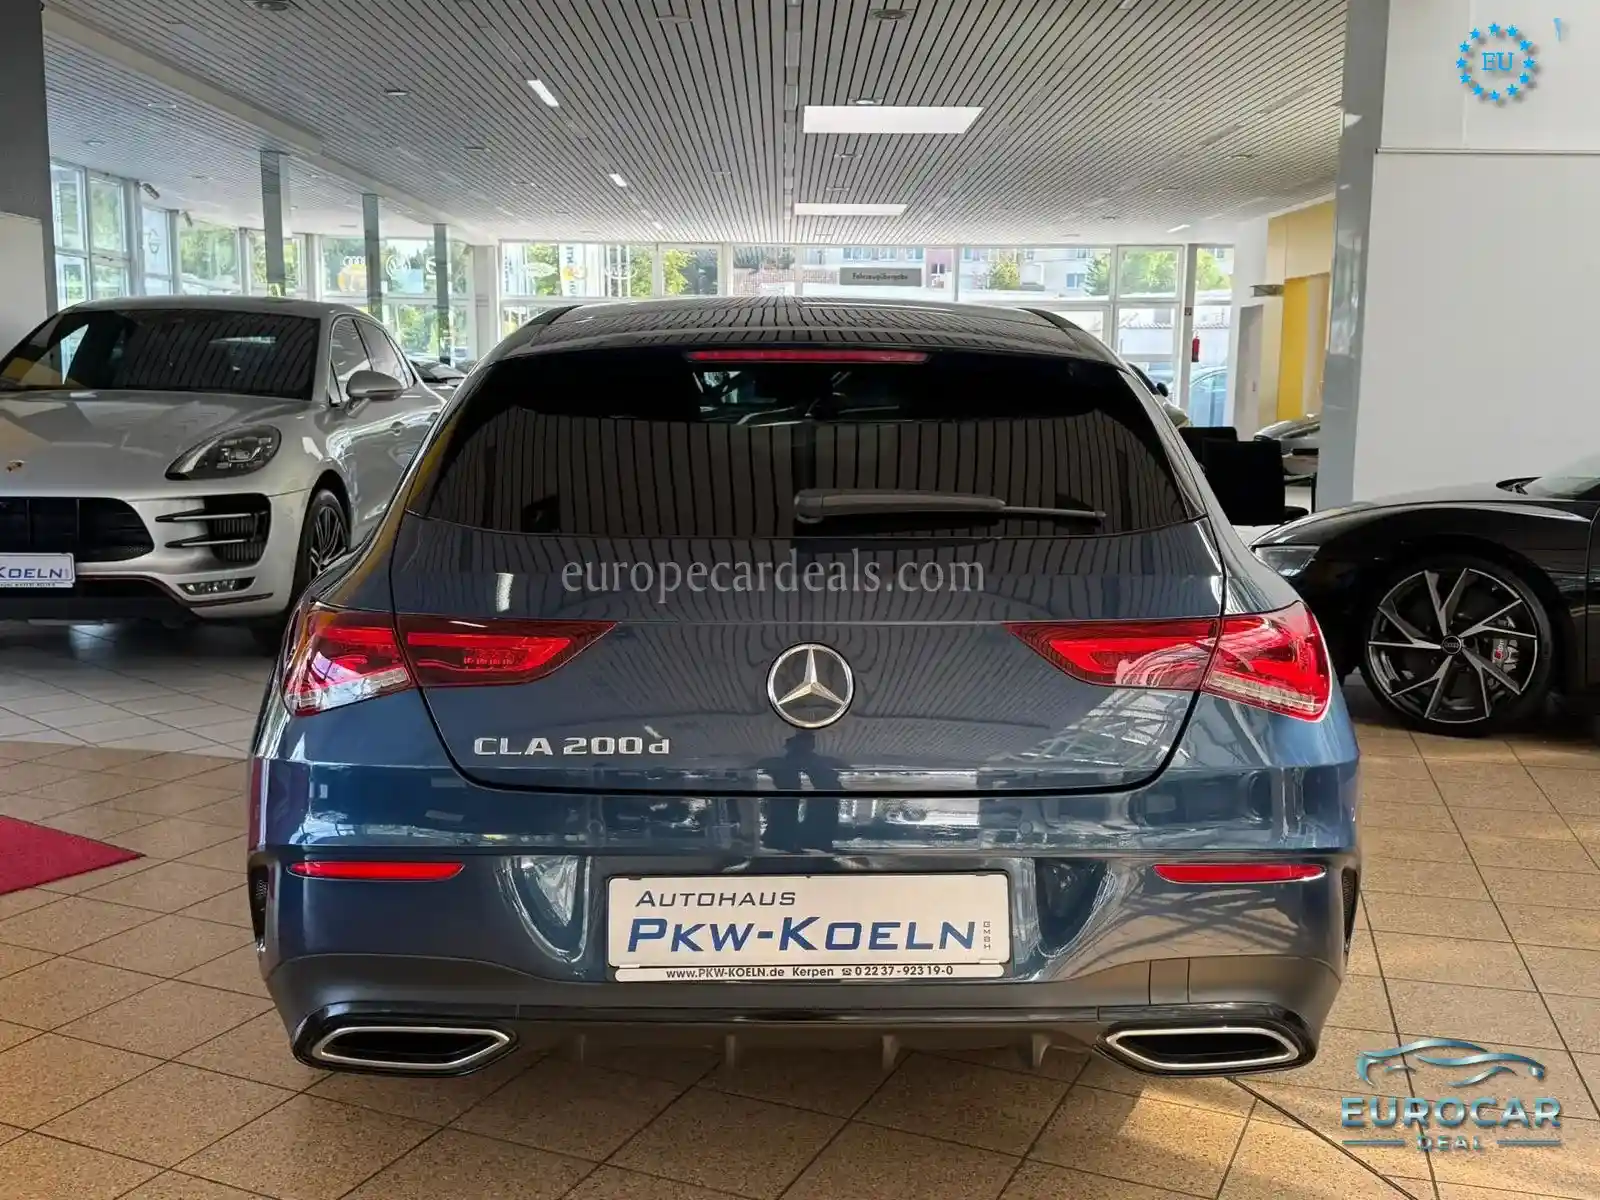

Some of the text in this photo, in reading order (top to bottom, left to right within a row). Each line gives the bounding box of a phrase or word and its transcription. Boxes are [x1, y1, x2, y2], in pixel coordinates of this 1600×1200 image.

[474, 737, 553, 756] CLA
[635, 890, 796, 908] AUTOHAUS
[627, 916, 976, 953] PKW-KOELN
[666, 967, 785, 979] www.PKW-KOELN.de
[792, 966, 834, 978] Kerpen
